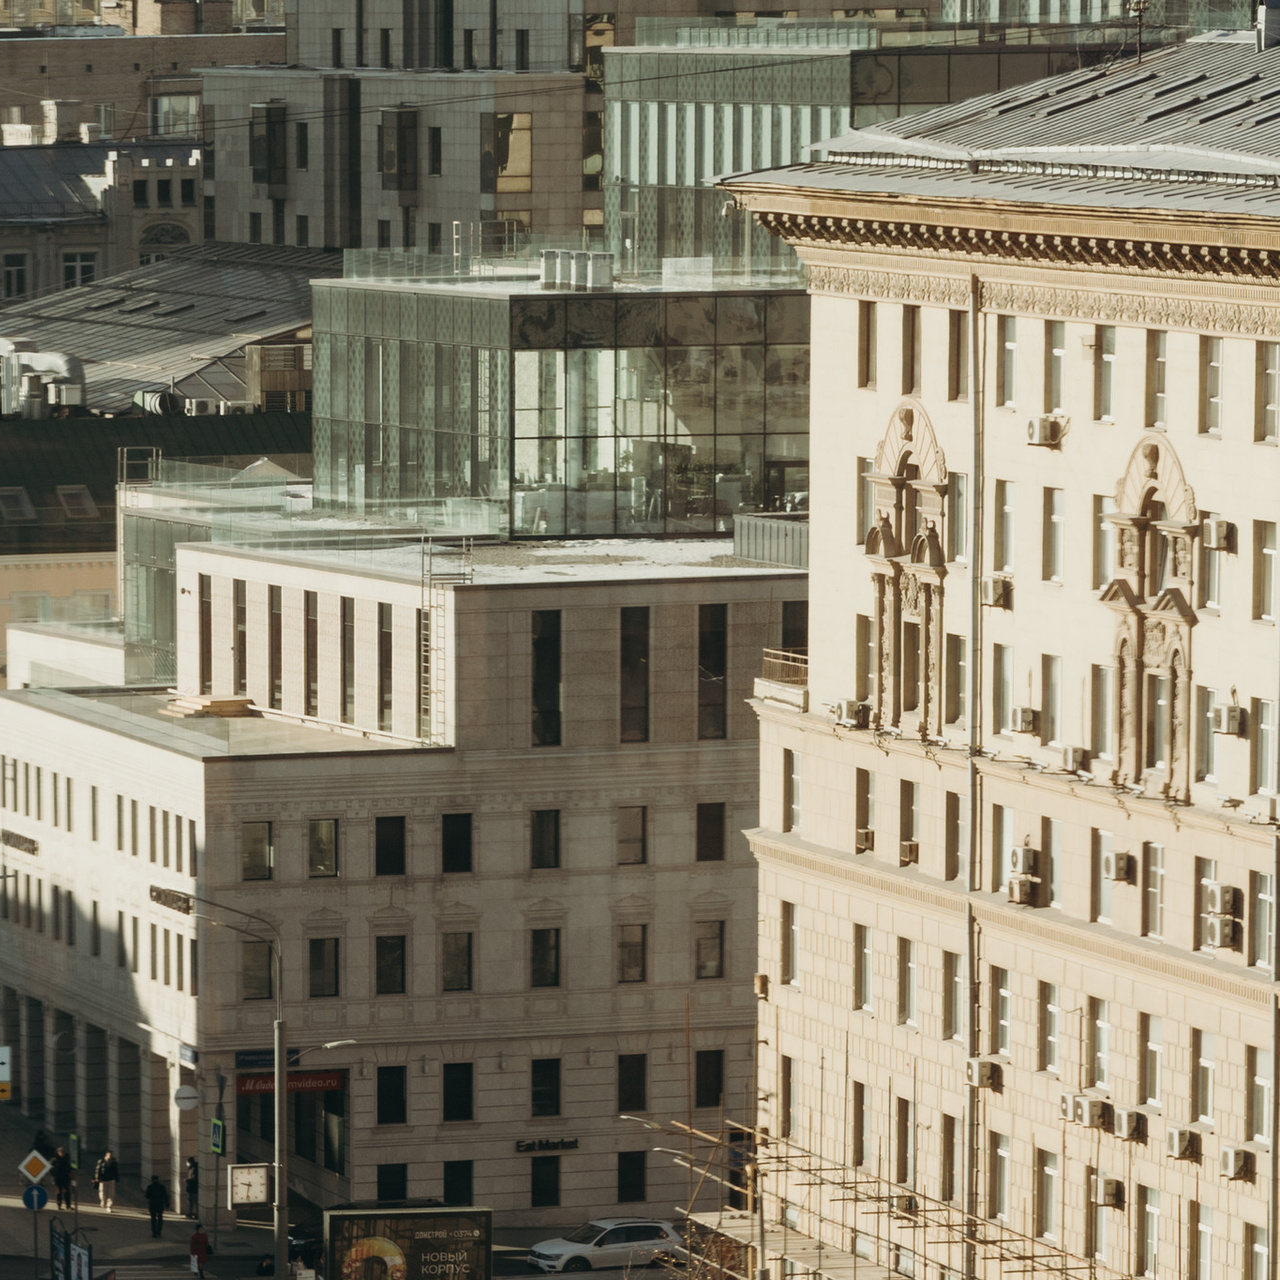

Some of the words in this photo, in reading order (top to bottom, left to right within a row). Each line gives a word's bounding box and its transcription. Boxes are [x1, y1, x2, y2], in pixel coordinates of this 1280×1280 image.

[287, 1078, 338, 1090] mvideo.ru
[516, 1140, 536, 1152] Eat
[538, 1138, 579, 1151] Market
[421, 1249, 468, 1262] НОВЫЙ
[421, 1263, 471, 1276] КОРПУС
